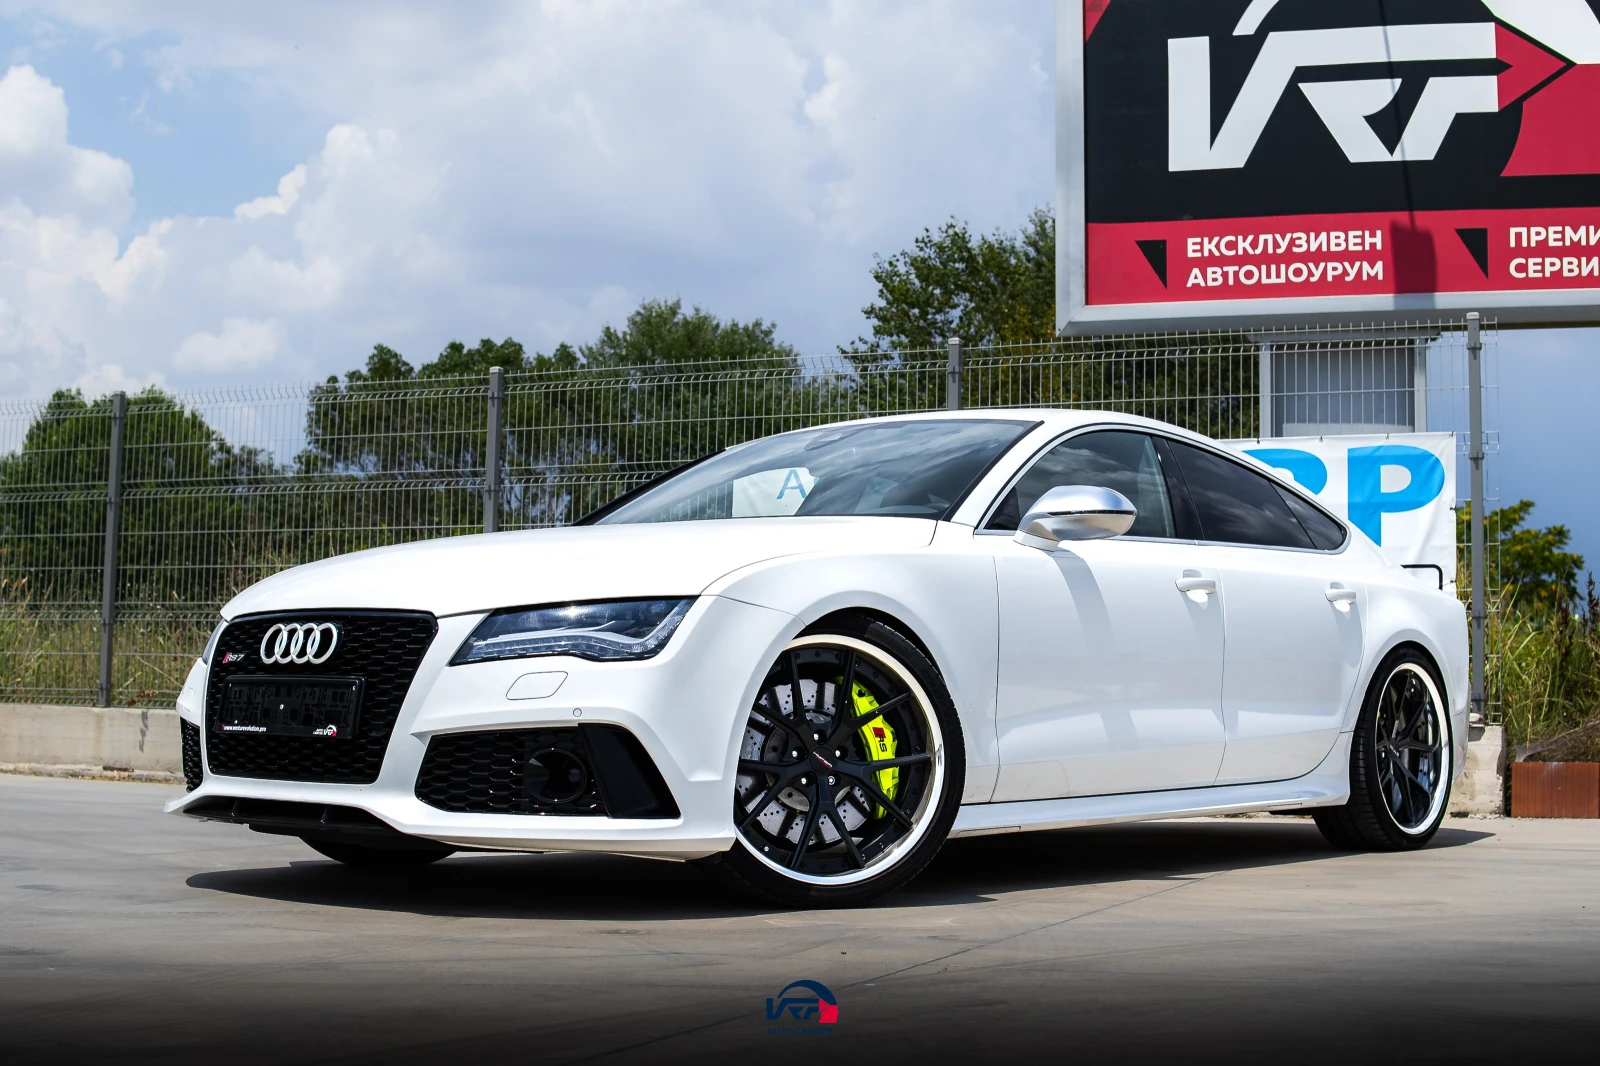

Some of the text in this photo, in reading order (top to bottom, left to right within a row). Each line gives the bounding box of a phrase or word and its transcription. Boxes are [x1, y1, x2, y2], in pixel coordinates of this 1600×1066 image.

[1186, 229, 1383, 258] ЕКСКЛУЗИВЕН
[1186, 259, 1385, 288] АВТОШОУРУМ
[1508, 256, 1600, 279] СЕРВИ
[776, 468, 820, 500] A
[874, 730, 888, 752] RS
